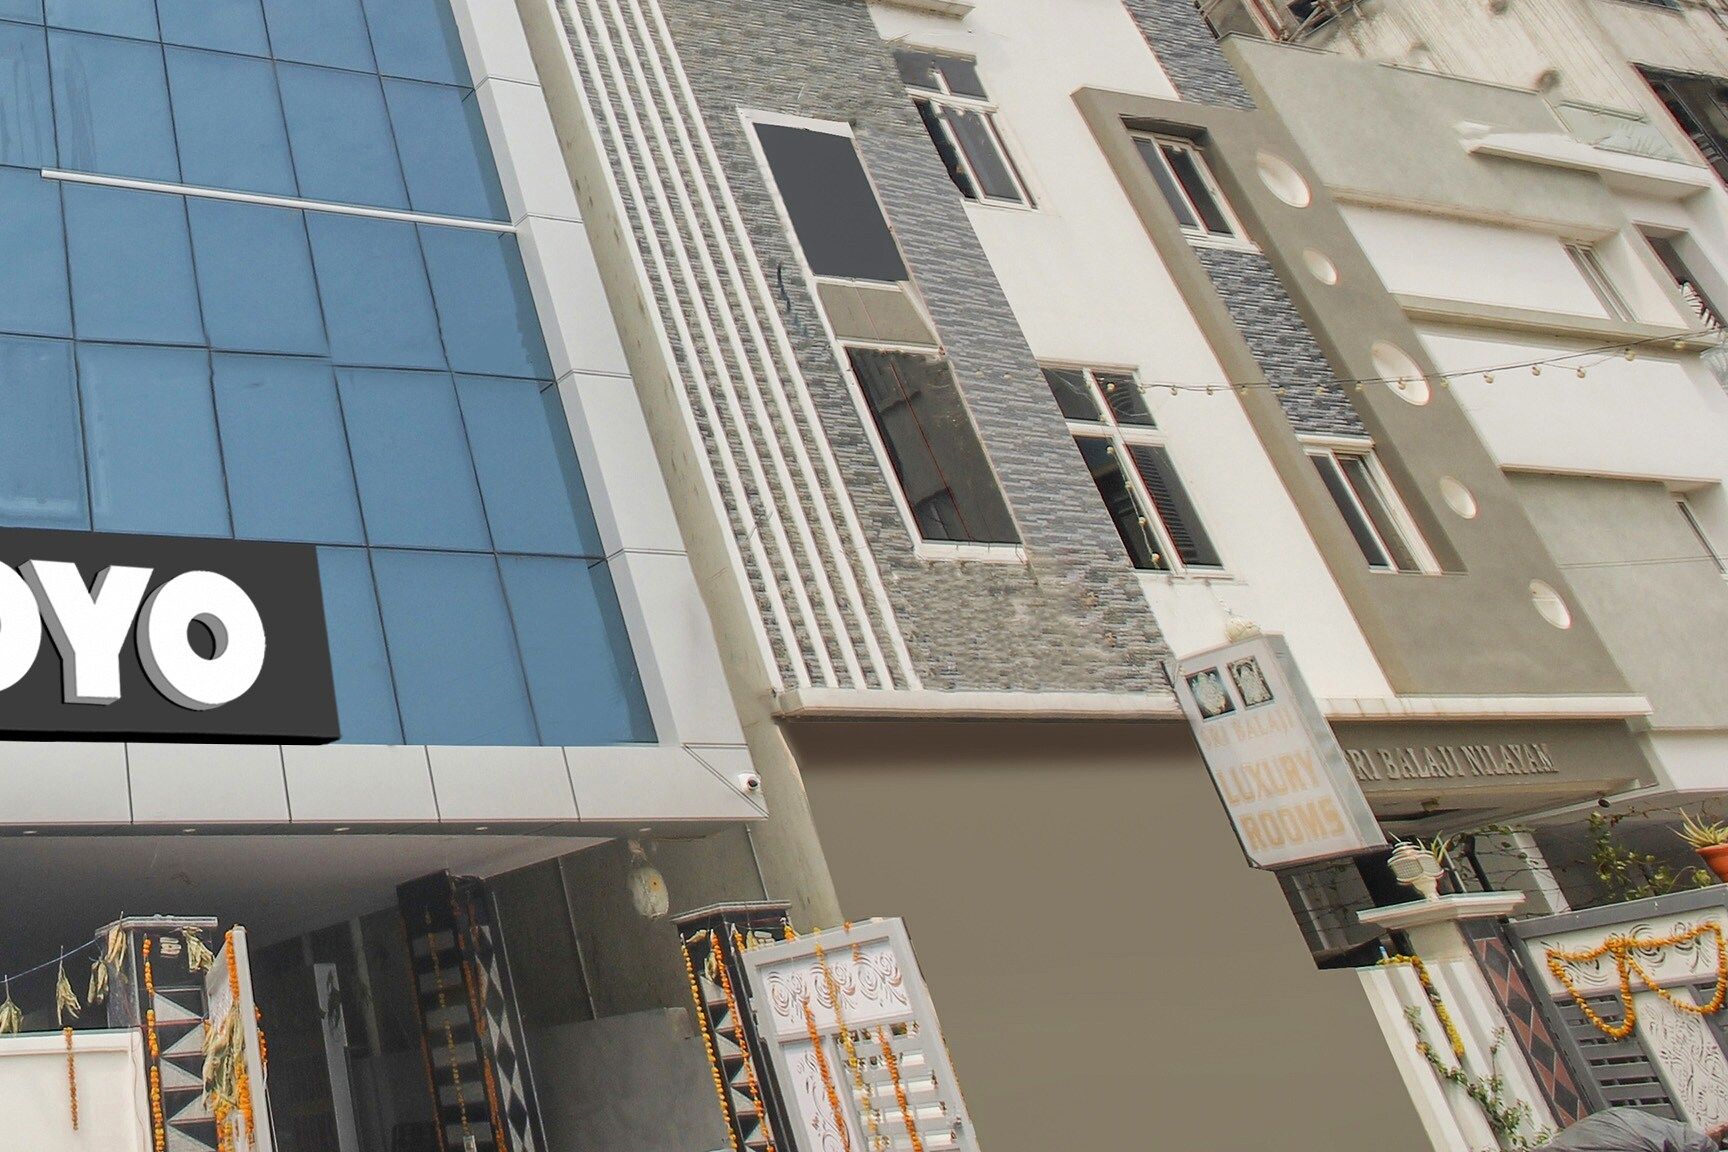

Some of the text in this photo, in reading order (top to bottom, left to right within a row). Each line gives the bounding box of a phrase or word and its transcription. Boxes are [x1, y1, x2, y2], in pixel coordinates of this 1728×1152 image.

[1216, 750, 1319, 806] LUXURY
[1345, 742, 1559, 781] RI BALAJI NILAYAM
[1238, 796, 1345, 852] ROOMS
